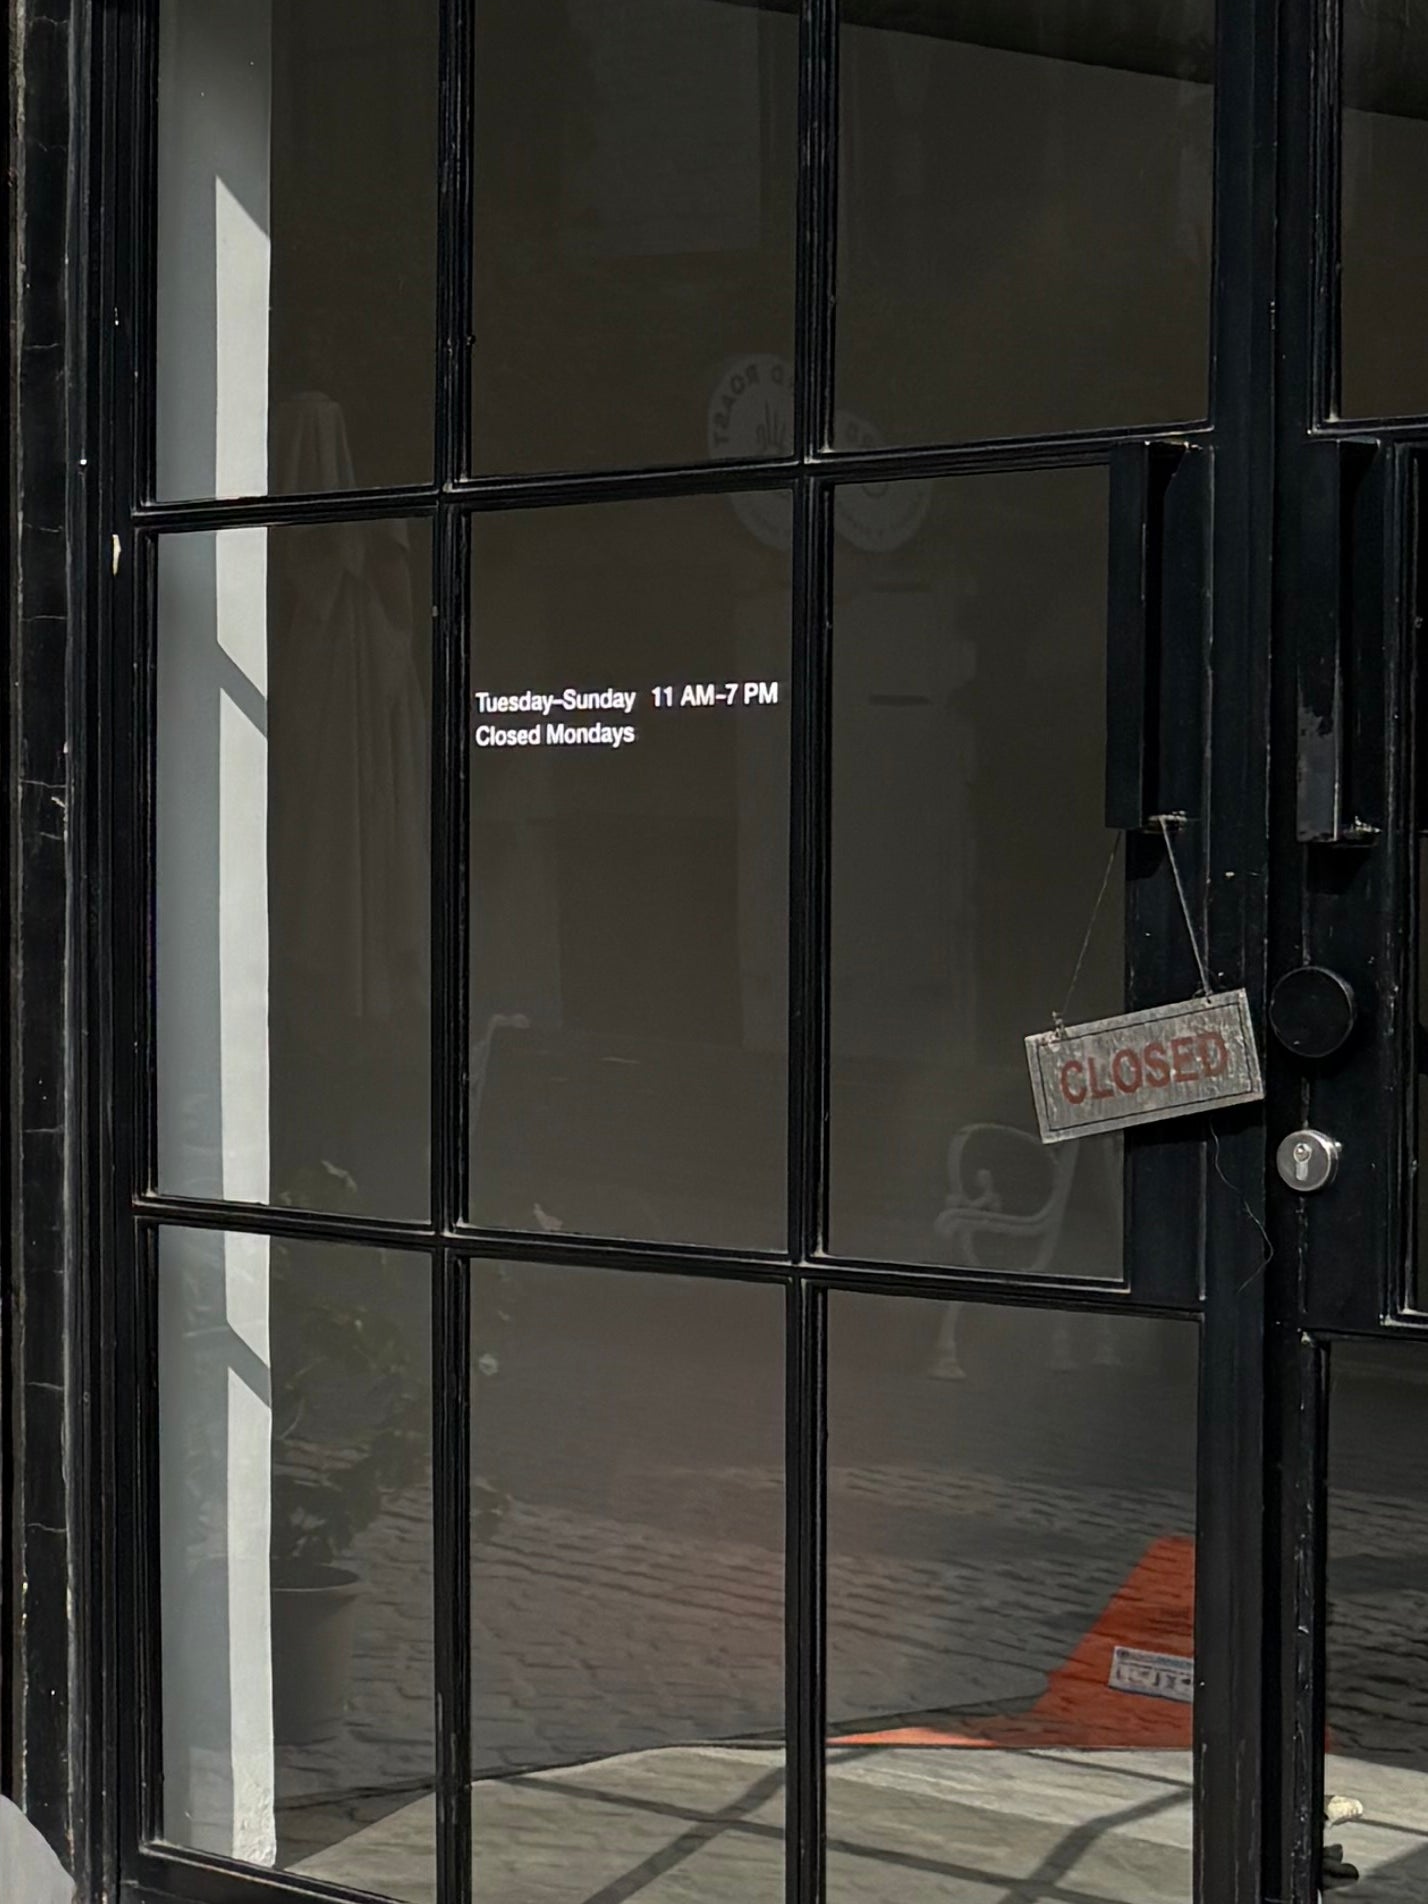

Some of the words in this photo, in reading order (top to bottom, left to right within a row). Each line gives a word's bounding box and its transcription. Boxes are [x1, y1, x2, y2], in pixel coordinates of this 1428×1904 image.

[651, 686, 674, 708] 11
[744, 682, 779, 705] PM
[475, 724, 541, 747] Closed
[546, 723, 636, 748] Mondays
[1060, 1029, 1229, 1105] CLOSED
